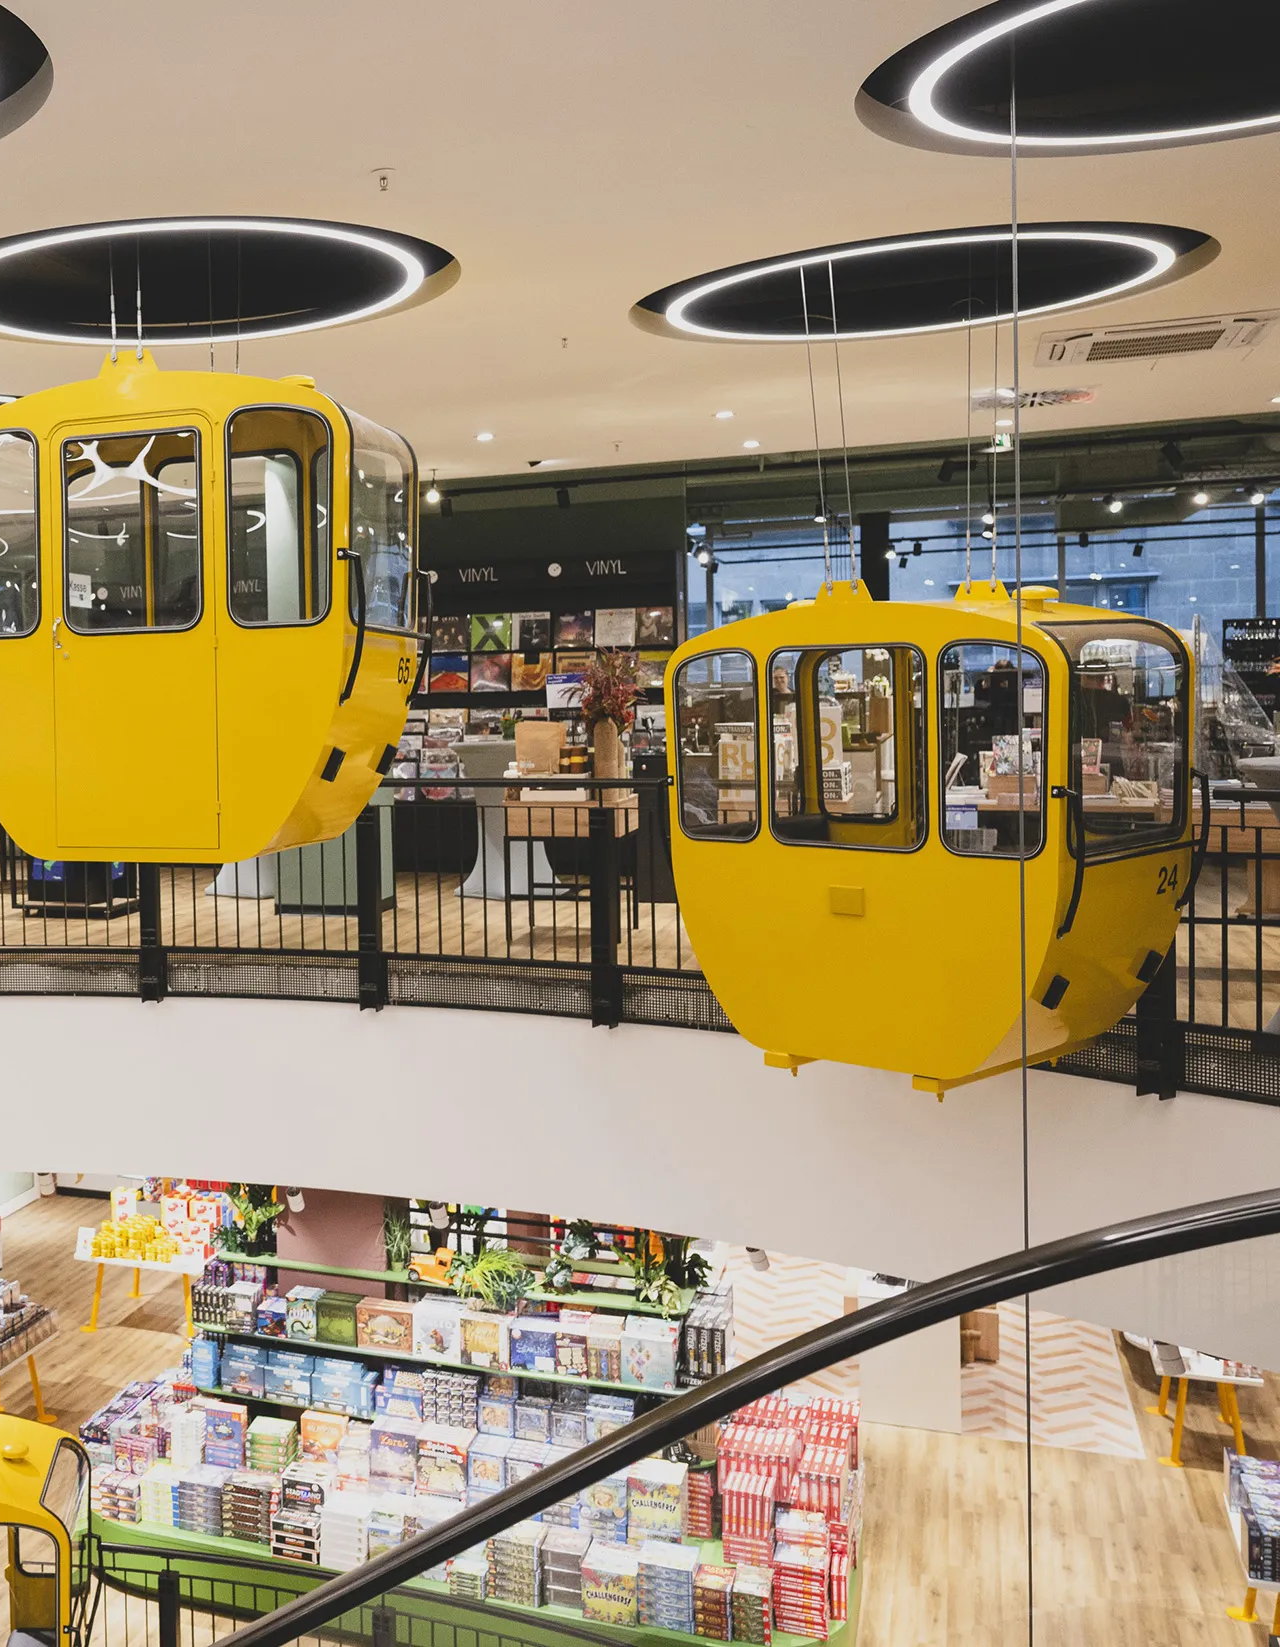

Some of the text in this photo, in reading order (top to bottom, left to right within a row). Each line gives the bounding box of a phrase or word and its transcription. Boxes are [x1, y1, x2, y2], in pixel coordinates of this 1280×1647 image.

[459, 566, 498, 583] VINYL
[586, 559, 627, 576] VINYL
[70, 580, 87, 593] Kasse
[232, 579, 262, 594] VINYL
[397, 657, 410, 685] 65
[1156, 864, 1178, 895] 24
[631, 1498, 677, 1514] CHALLENGERS!
[703, 1565, 732, 1576] CATAN
[586, 1589, 632, 1606] CHALLENGERS!
